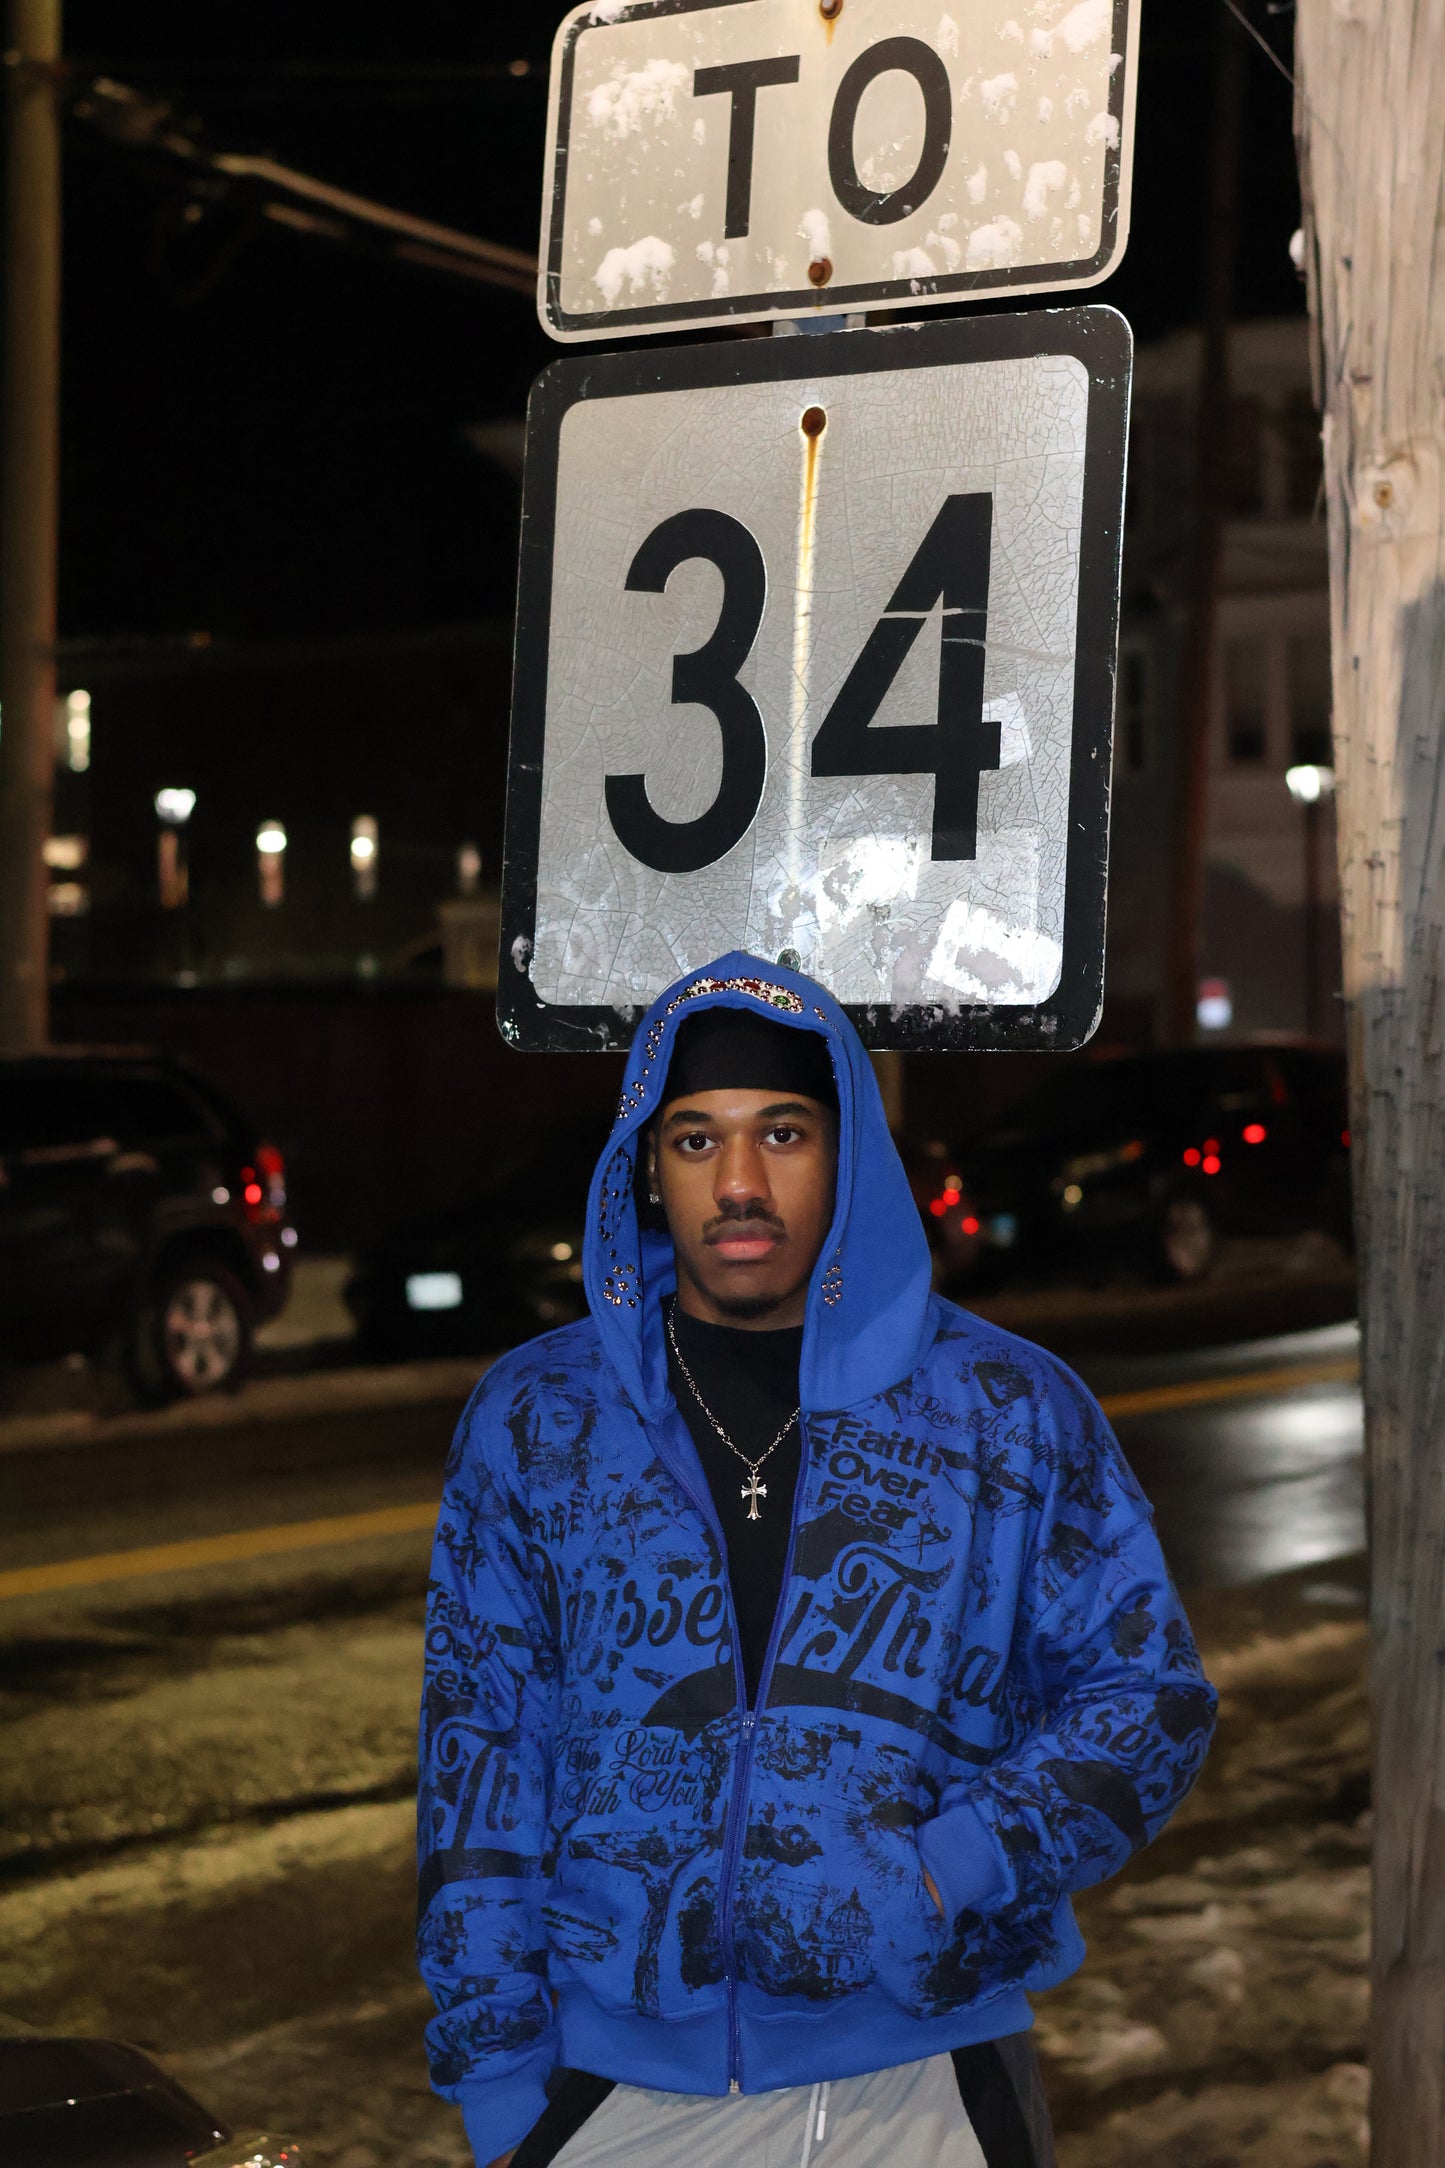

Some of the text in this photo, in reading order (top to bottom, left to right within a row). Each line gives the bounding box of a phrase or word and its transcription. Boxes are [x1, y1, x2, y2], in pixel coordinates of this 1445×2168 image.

[693, 36, 953, 240] TO
[604, 492, 1002, 874] 34
[831, 1418, 943, 1477] Faith
[828, 1450, 929, 1500] Over
[816, 1480, 918, 1531] Fear
[609, 1728, 680, 1775] Lord
[629, 1768, 700, 1813] You
